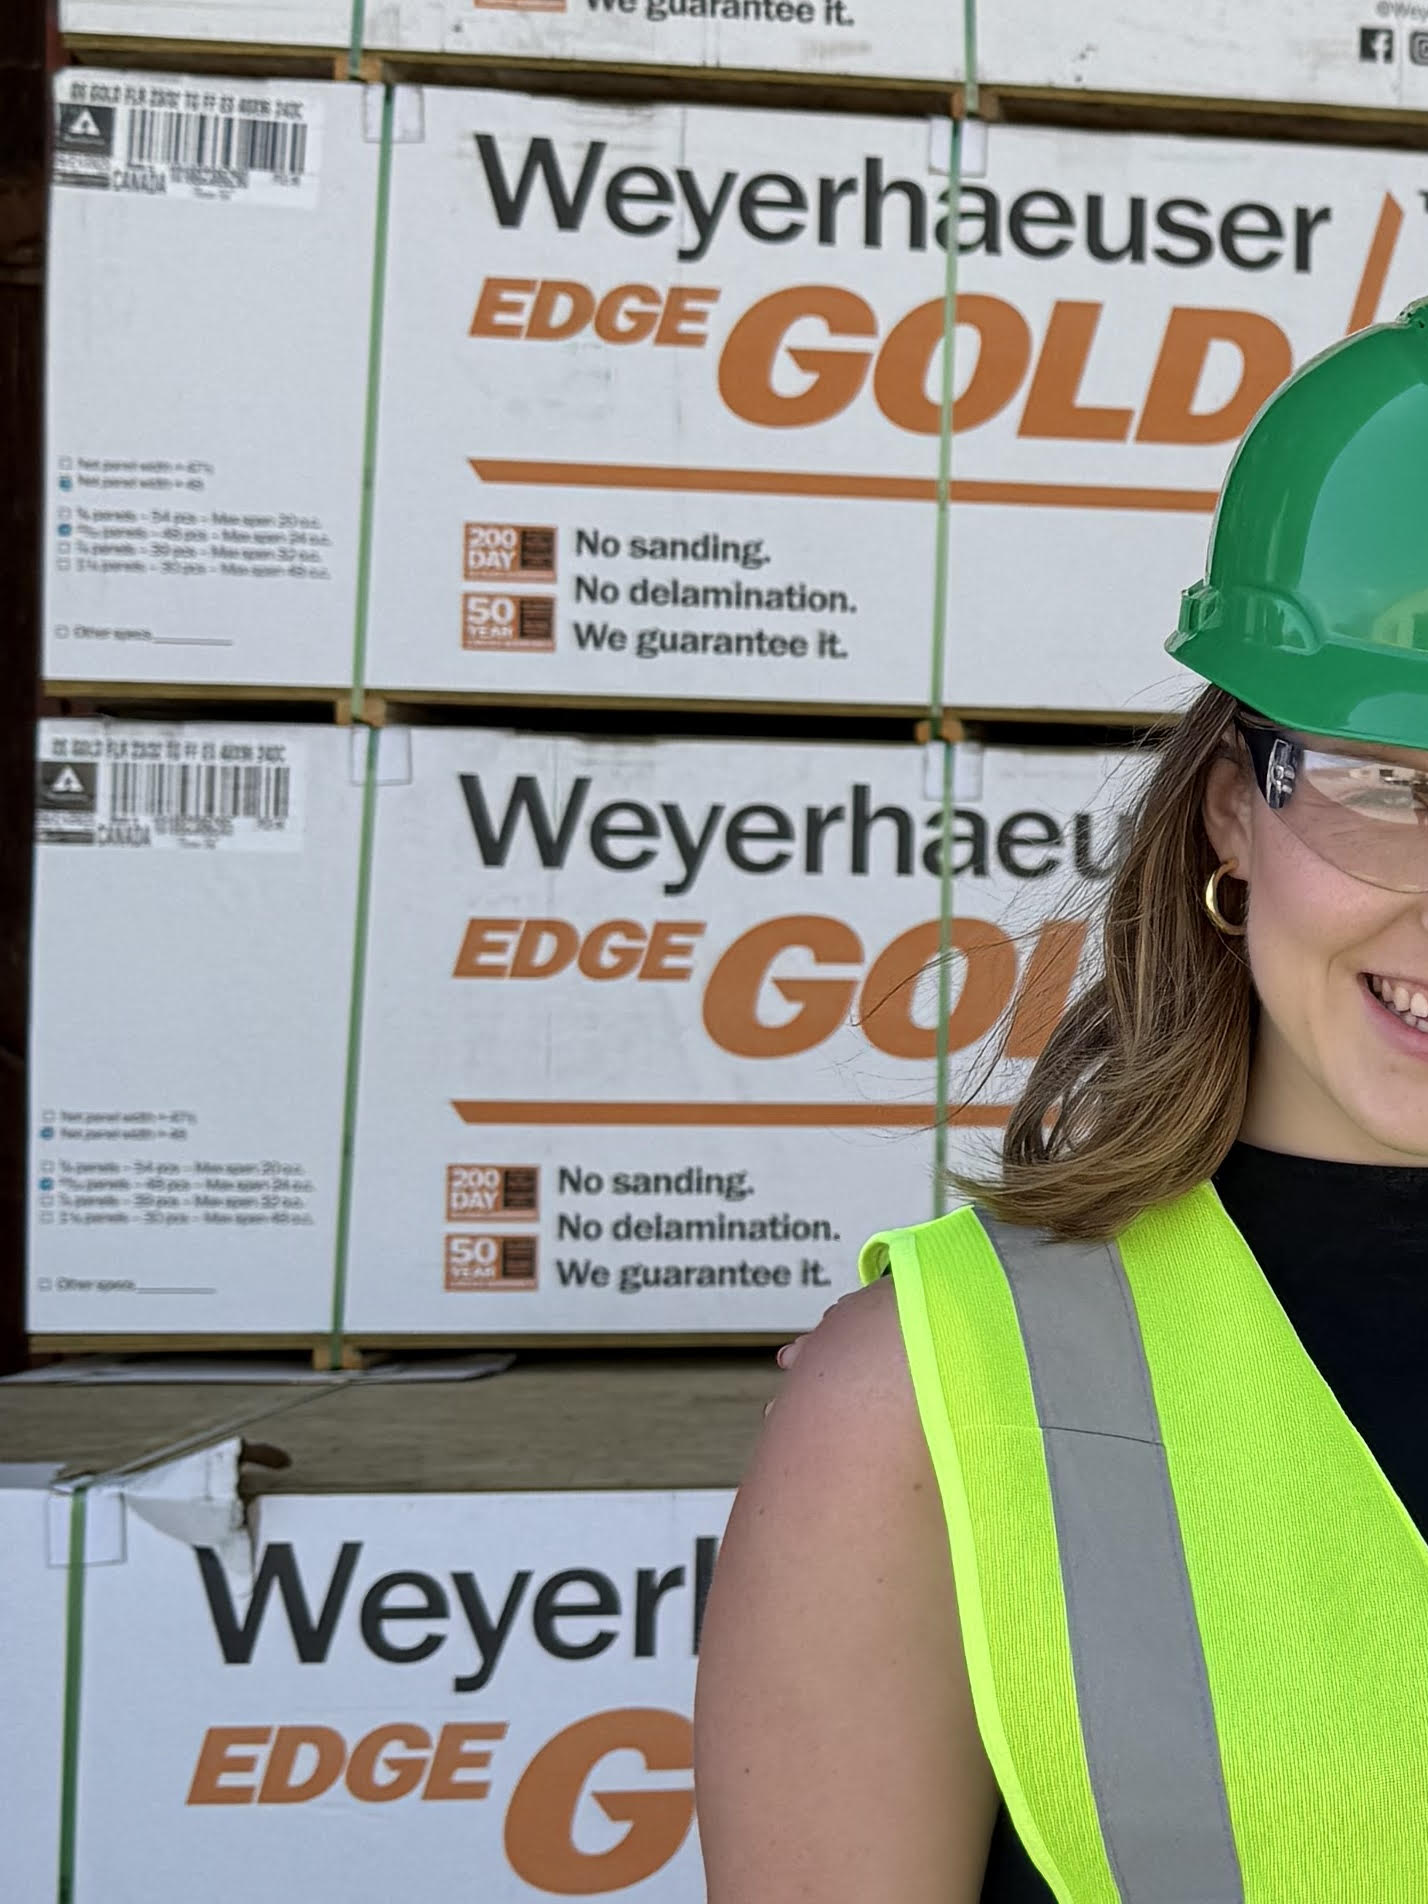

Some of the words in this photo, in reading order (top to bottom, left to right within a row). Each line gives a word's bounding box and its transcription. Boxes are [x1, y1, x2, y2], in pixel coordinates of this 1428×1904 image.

[476, 129, 1332, 280] Weyerhaeuser
[470, 276, 717, 348] EDGE
[717, 283, 1294, 446] GOLD
[468, 527, 516, 547] 200
[575, 527, 619, 557] No
[631, 534, 769, 569] sanding.
[467, 550, 515, 569] DAY
[466, 597, 514, 624] 50
[575, 575, 619, 605] No
[631, 578, 853, 613] delamination.
[574, 621, 626, 651] We
[638, 628, 805, 659] guarantee
[818, 630, 846, 659] it.
[461, 772, 1135, 894] Weyerhaeu
[454, 917, 703, 982] EDGE
[701, 914, 1087, 1061] GOL
[451, 1190, 498, 1210] DAY
[559, 1166, 603, 1194] No
[615, 1167, 753, 1201] sanding.
[558, 1213, 602, 1241] No
[615, 1213, 837, 1242] delamination.
[449, 1238, 497, 1265] 50
[557, 1260, 609, 1289] We
[621, 1260, 789, 1293] guarantee
[801, 1259, 829, 1287] it.
[187, 1721, 506, 1807] EDGE
